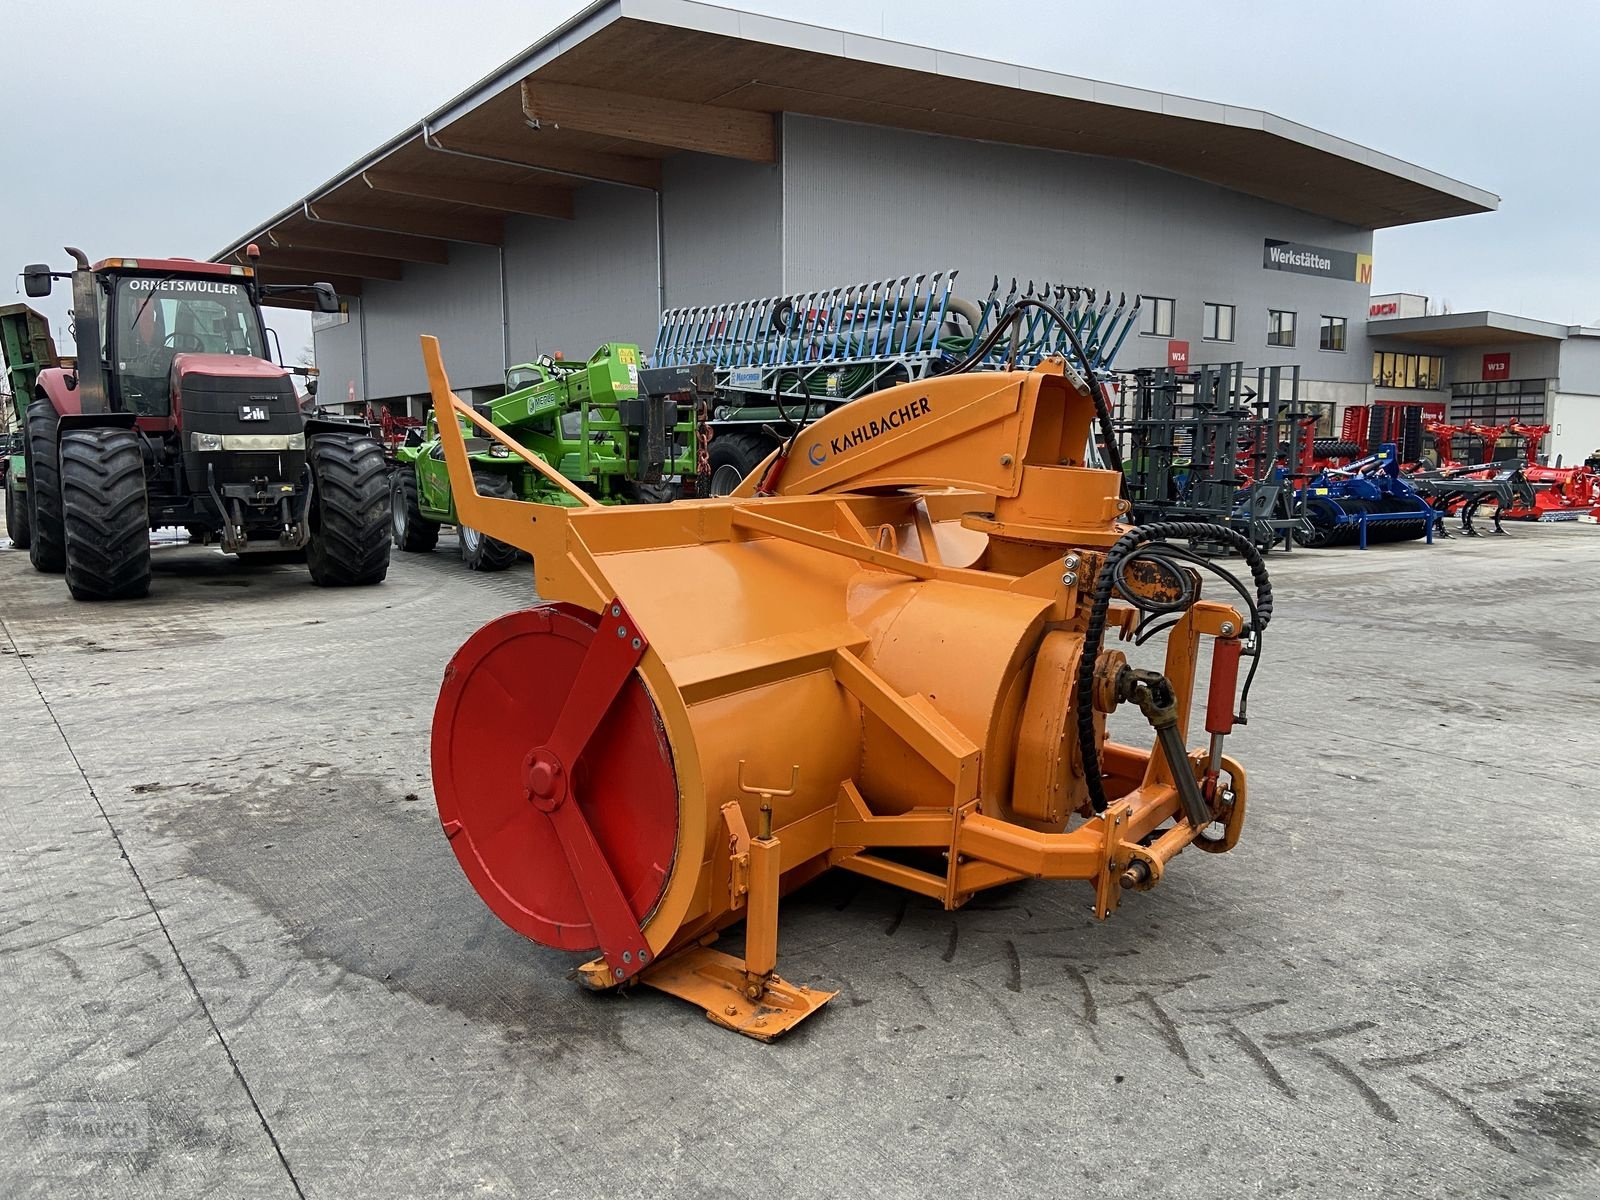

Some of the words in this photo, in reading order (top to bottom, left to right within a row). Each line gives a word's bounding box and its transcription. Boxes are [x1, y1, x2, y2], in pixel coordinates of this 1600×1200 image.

[1270, 246, 1331, 271] Werkstätten
[129, 280, 239, 295] ORNETSMÜLLER
[1370, 302, 1397, 317] UCH
[1172, 352, 1186, 361] W14
[1487, 363, 1505, 371] W13
[830, 397, 931, 455] KAHLBACHER
